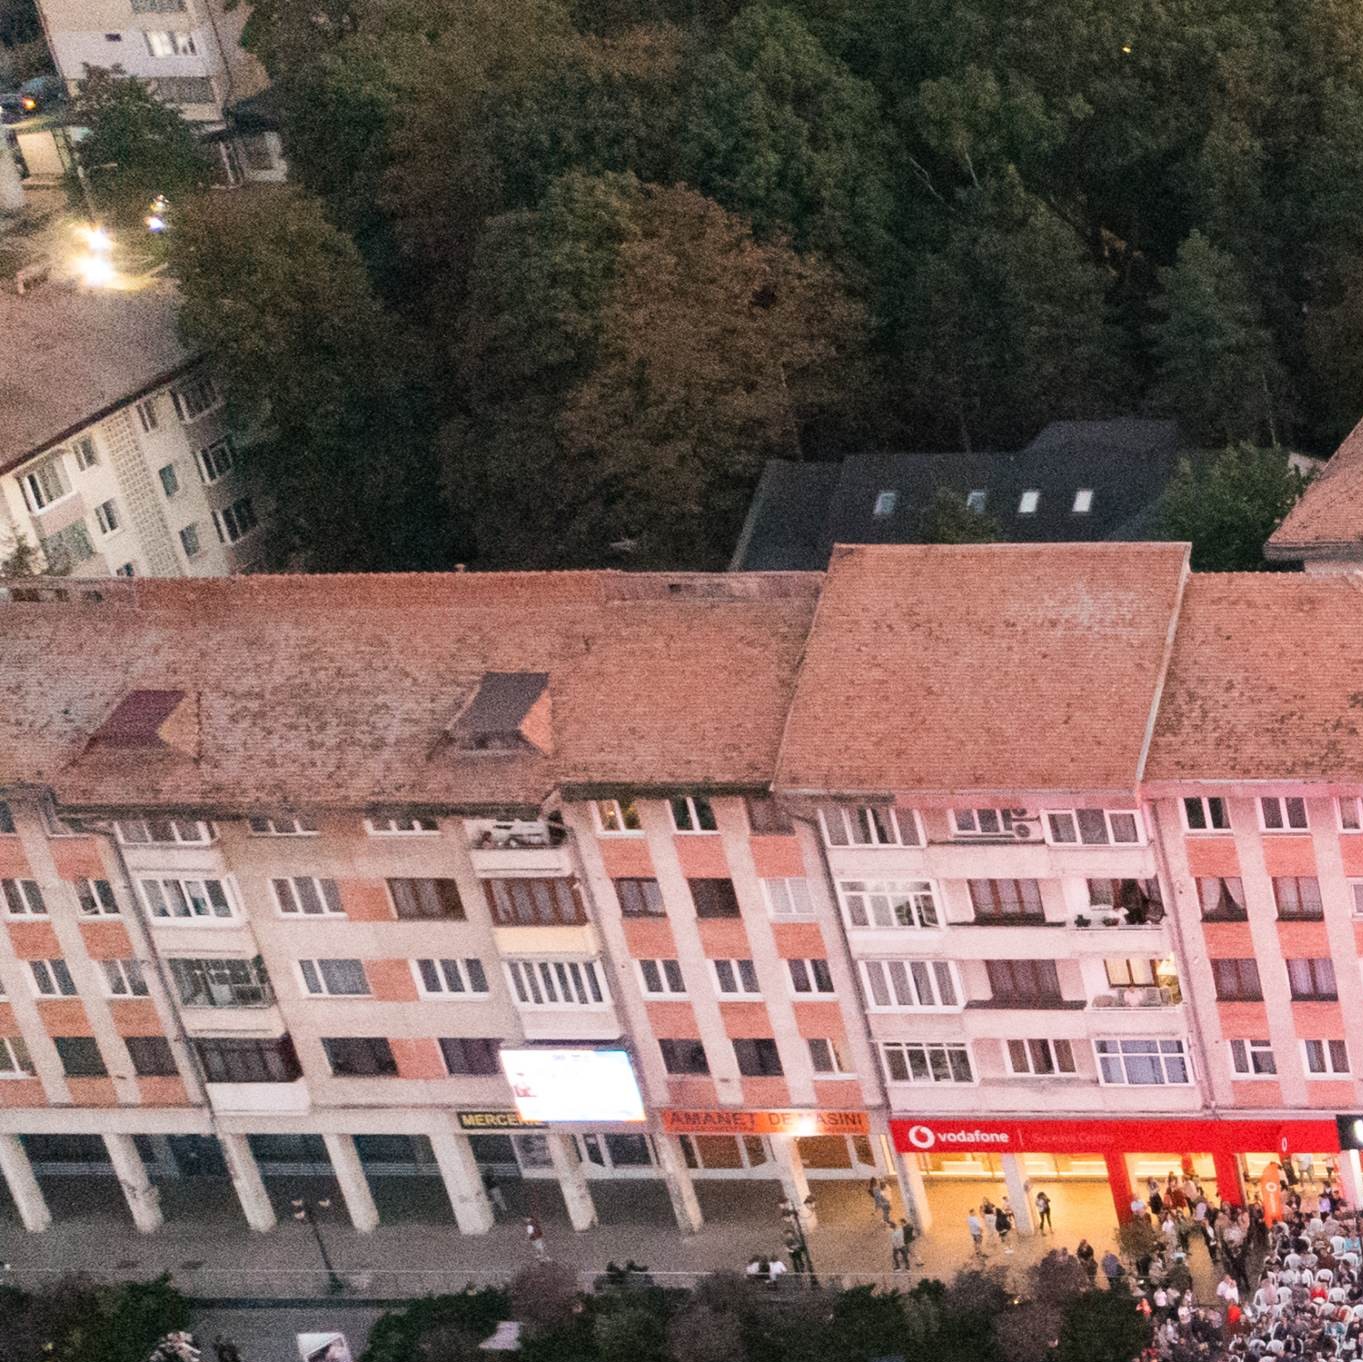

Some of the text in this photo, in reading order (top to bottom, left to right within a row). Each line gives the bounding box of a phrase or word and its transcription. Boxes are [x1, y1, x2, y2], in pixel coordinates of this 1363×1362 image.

[769, 1112, 793, 1126] DE
[802, 1112, 862, 1126] ASINI
[937, 1129, 1009, 1143] vodafone
